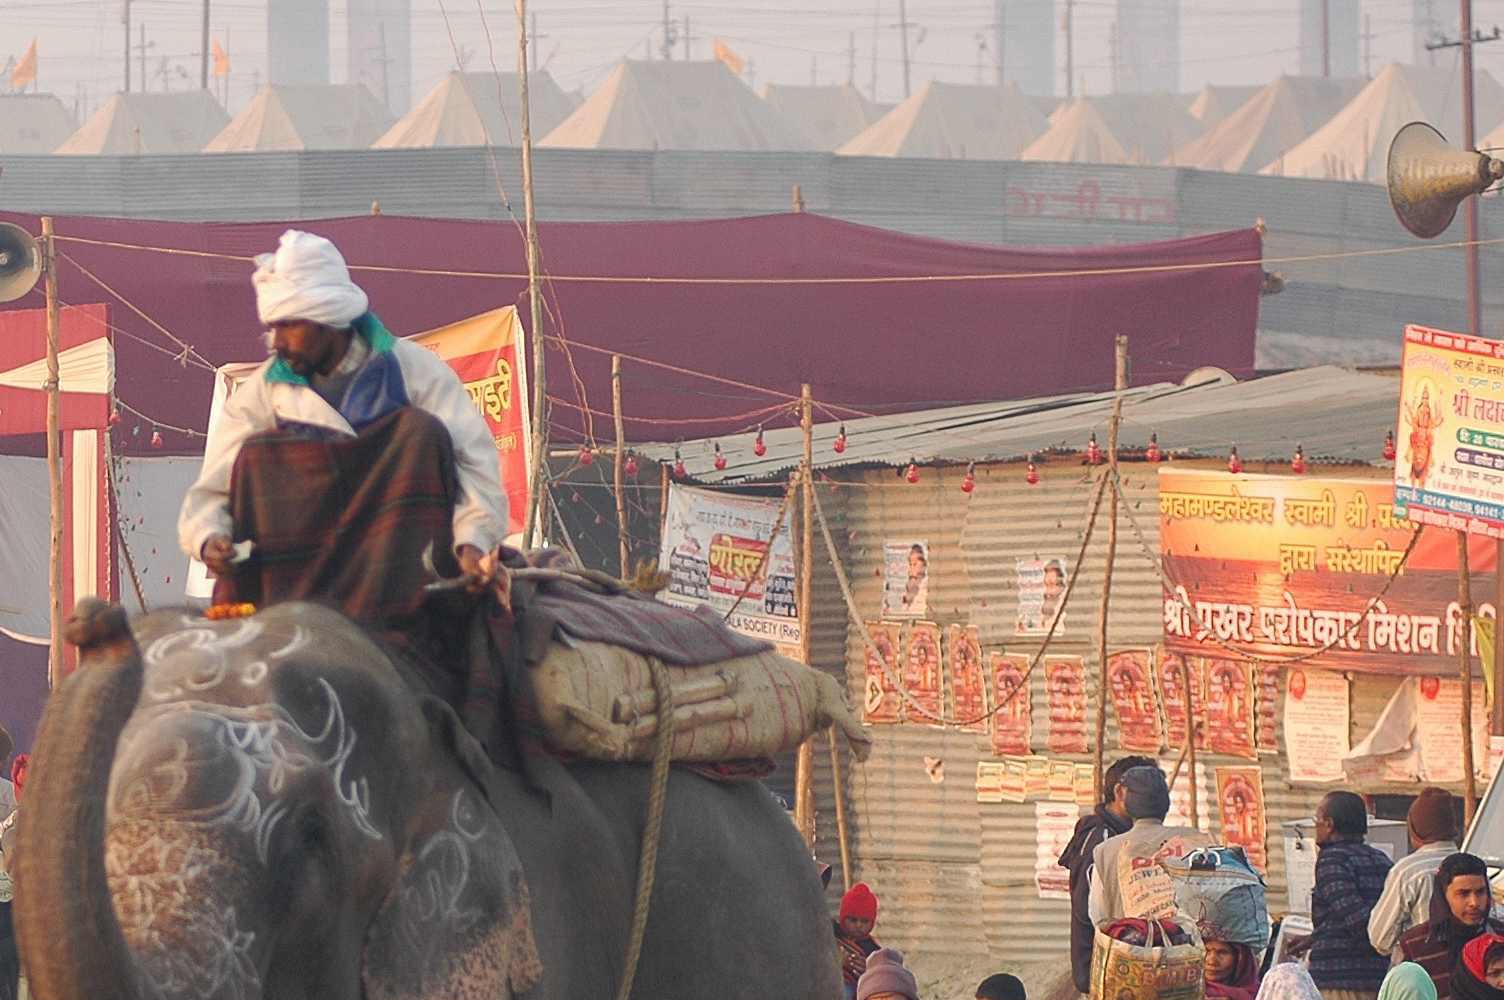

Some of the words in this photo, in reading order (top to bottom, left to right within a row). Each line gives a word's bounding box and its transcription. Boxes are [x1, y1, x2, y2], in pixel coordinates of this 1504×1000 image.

[1453, 388, 1470, 416] श्री
[1159, 484, 1275, 523] महामण्डलेश्वर
[1284, 489, 1336, 527] स्वामी
[1345, 491, 1369, 530] श्री
[1279, 543, 1317, 576] द्वारा
[743, 617, 778, 635] SOCIETY
[1164, 585, 1192, 637] श्री
[1196, 601, 1255, 644] प्रखर
[1258, 591, 1362, 650] परोपकार
[1366, 597, 1442, 656] मिशन
[1128, 866, 1165, 885] JEWE
